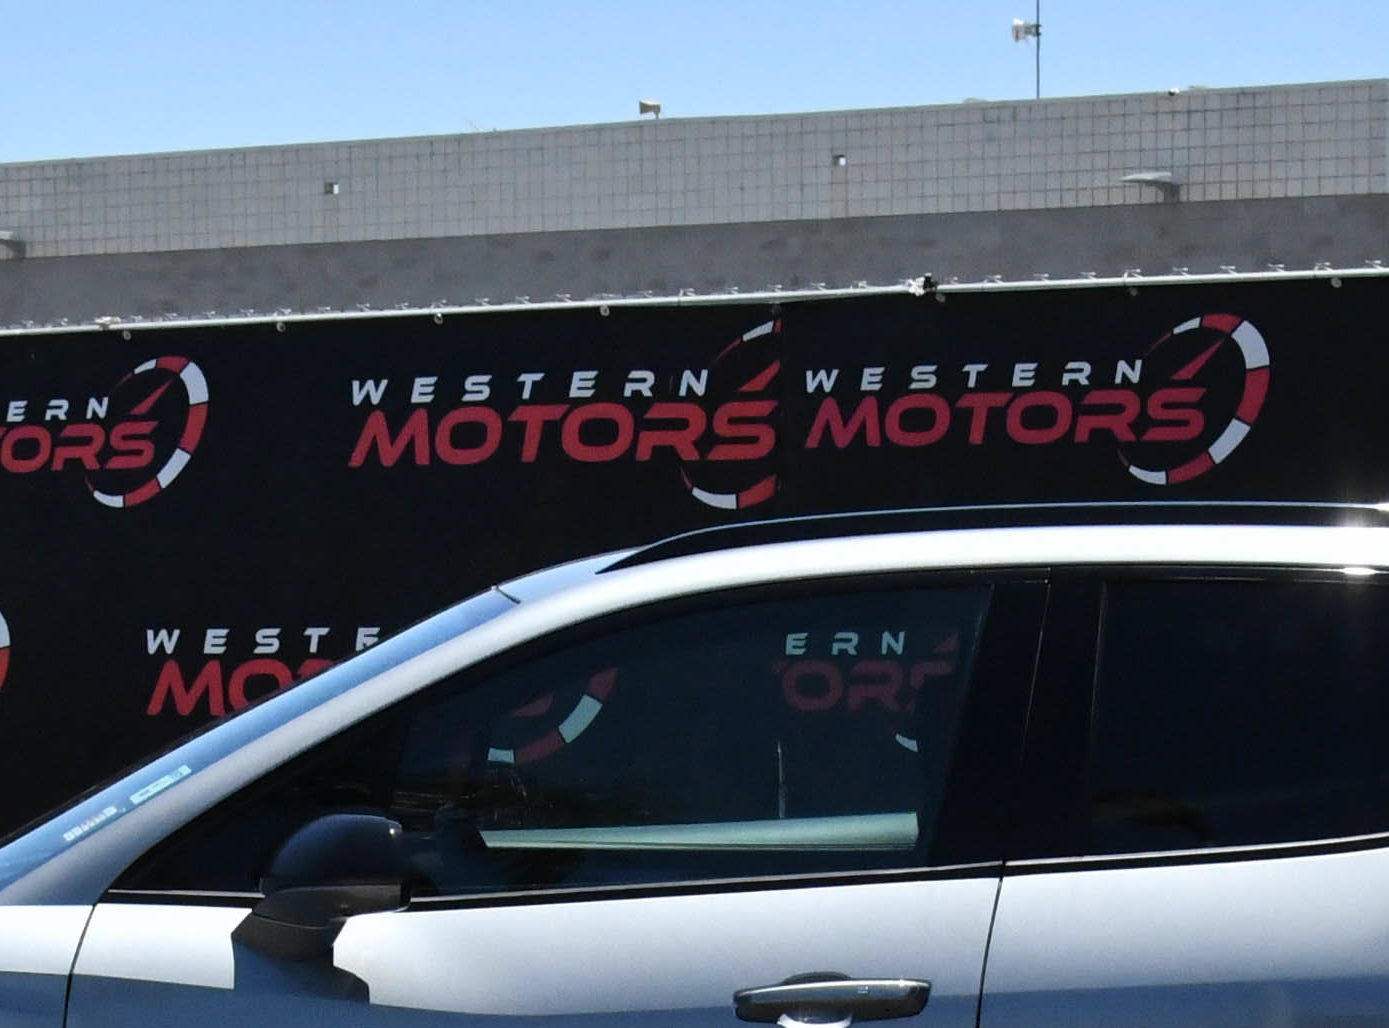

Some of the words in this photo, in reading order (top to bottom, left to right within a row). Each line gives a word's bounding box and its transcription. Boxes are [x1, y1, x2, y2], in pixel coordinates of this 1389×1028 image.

[353, 370, 708, 405] WESTERN
[806, 360, 1142, 393] WESTERN
[350, 400, 776, 467] MOTORS
[807, 388, 1204, 448] MOTORS
[786, 632, 904, 654] ERN
[772, 659, 953, 713] OR
